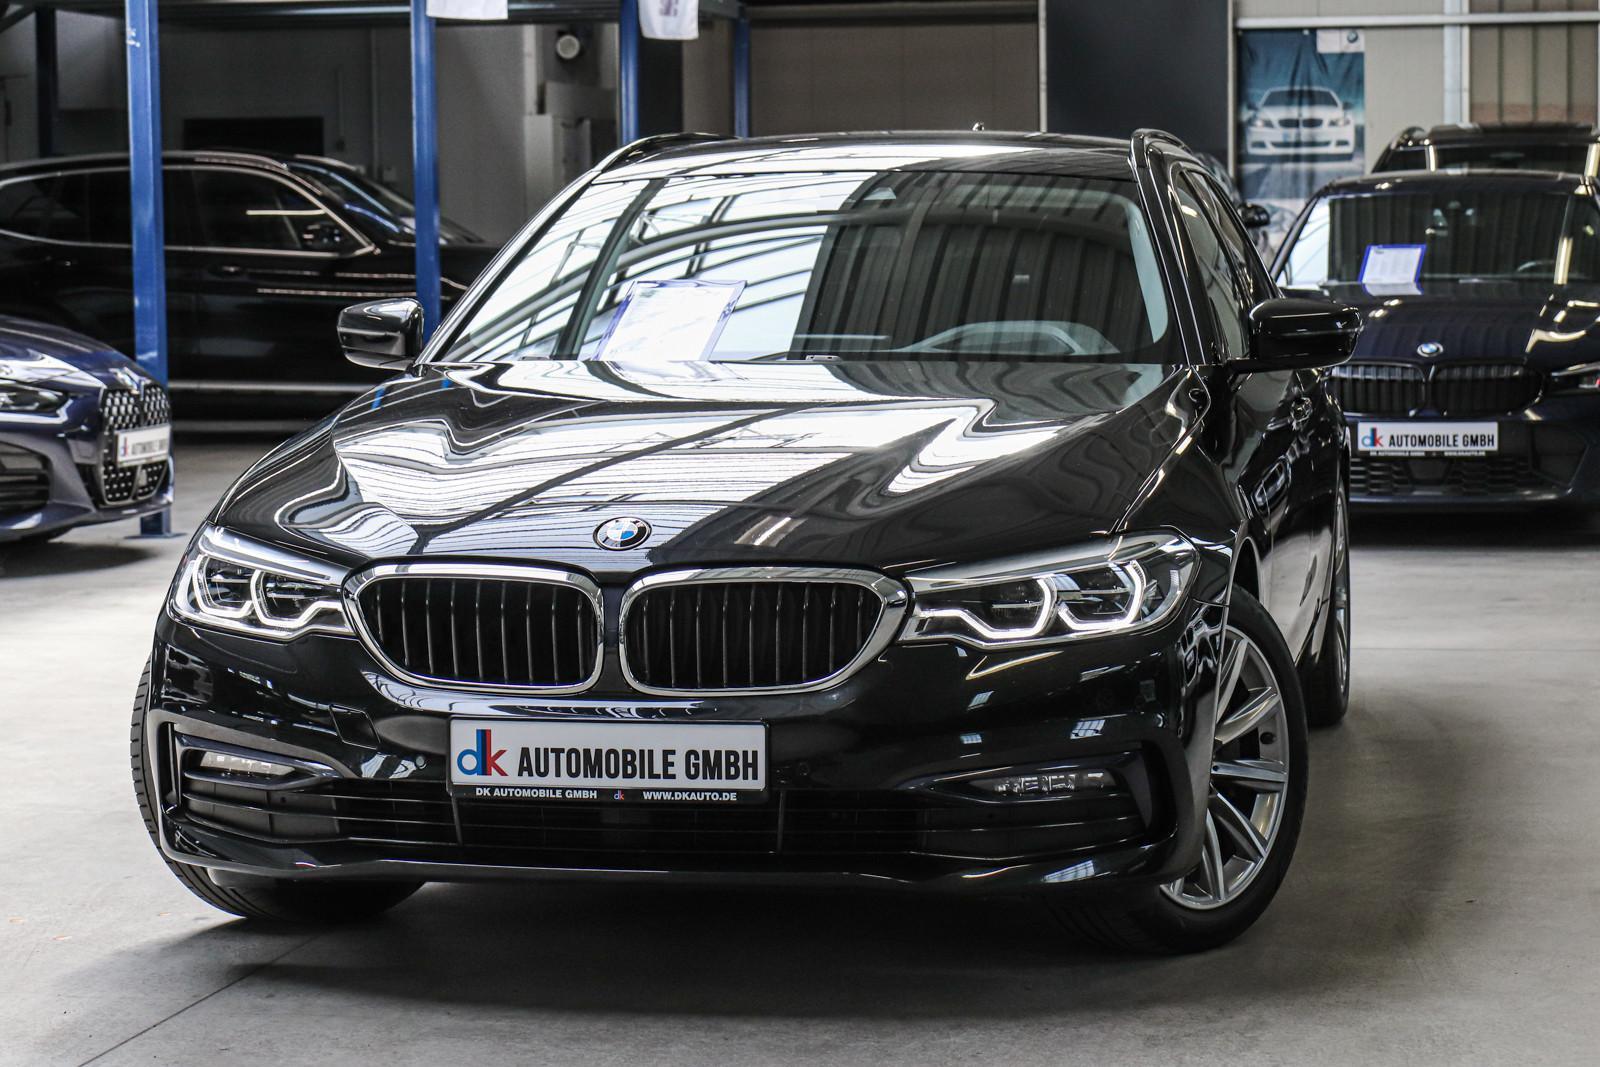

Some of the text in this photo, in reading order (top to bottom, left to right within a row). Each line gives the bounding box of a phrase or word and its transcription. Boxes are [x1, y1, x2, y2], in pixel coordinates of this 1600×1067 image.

[1361, 427, 1495, 447] dk AUTOMOBILE GMBH
[456, 728, 759, 781] dk AUTOMOBILE GMBH
[475, 787, 491, 797] DK
[493, 787, 561, 799] AUTOMOBILE
[565, 789, 598, 799] GMBH
[642, 791, 737, 801] WWW.DKAUTO.DE
